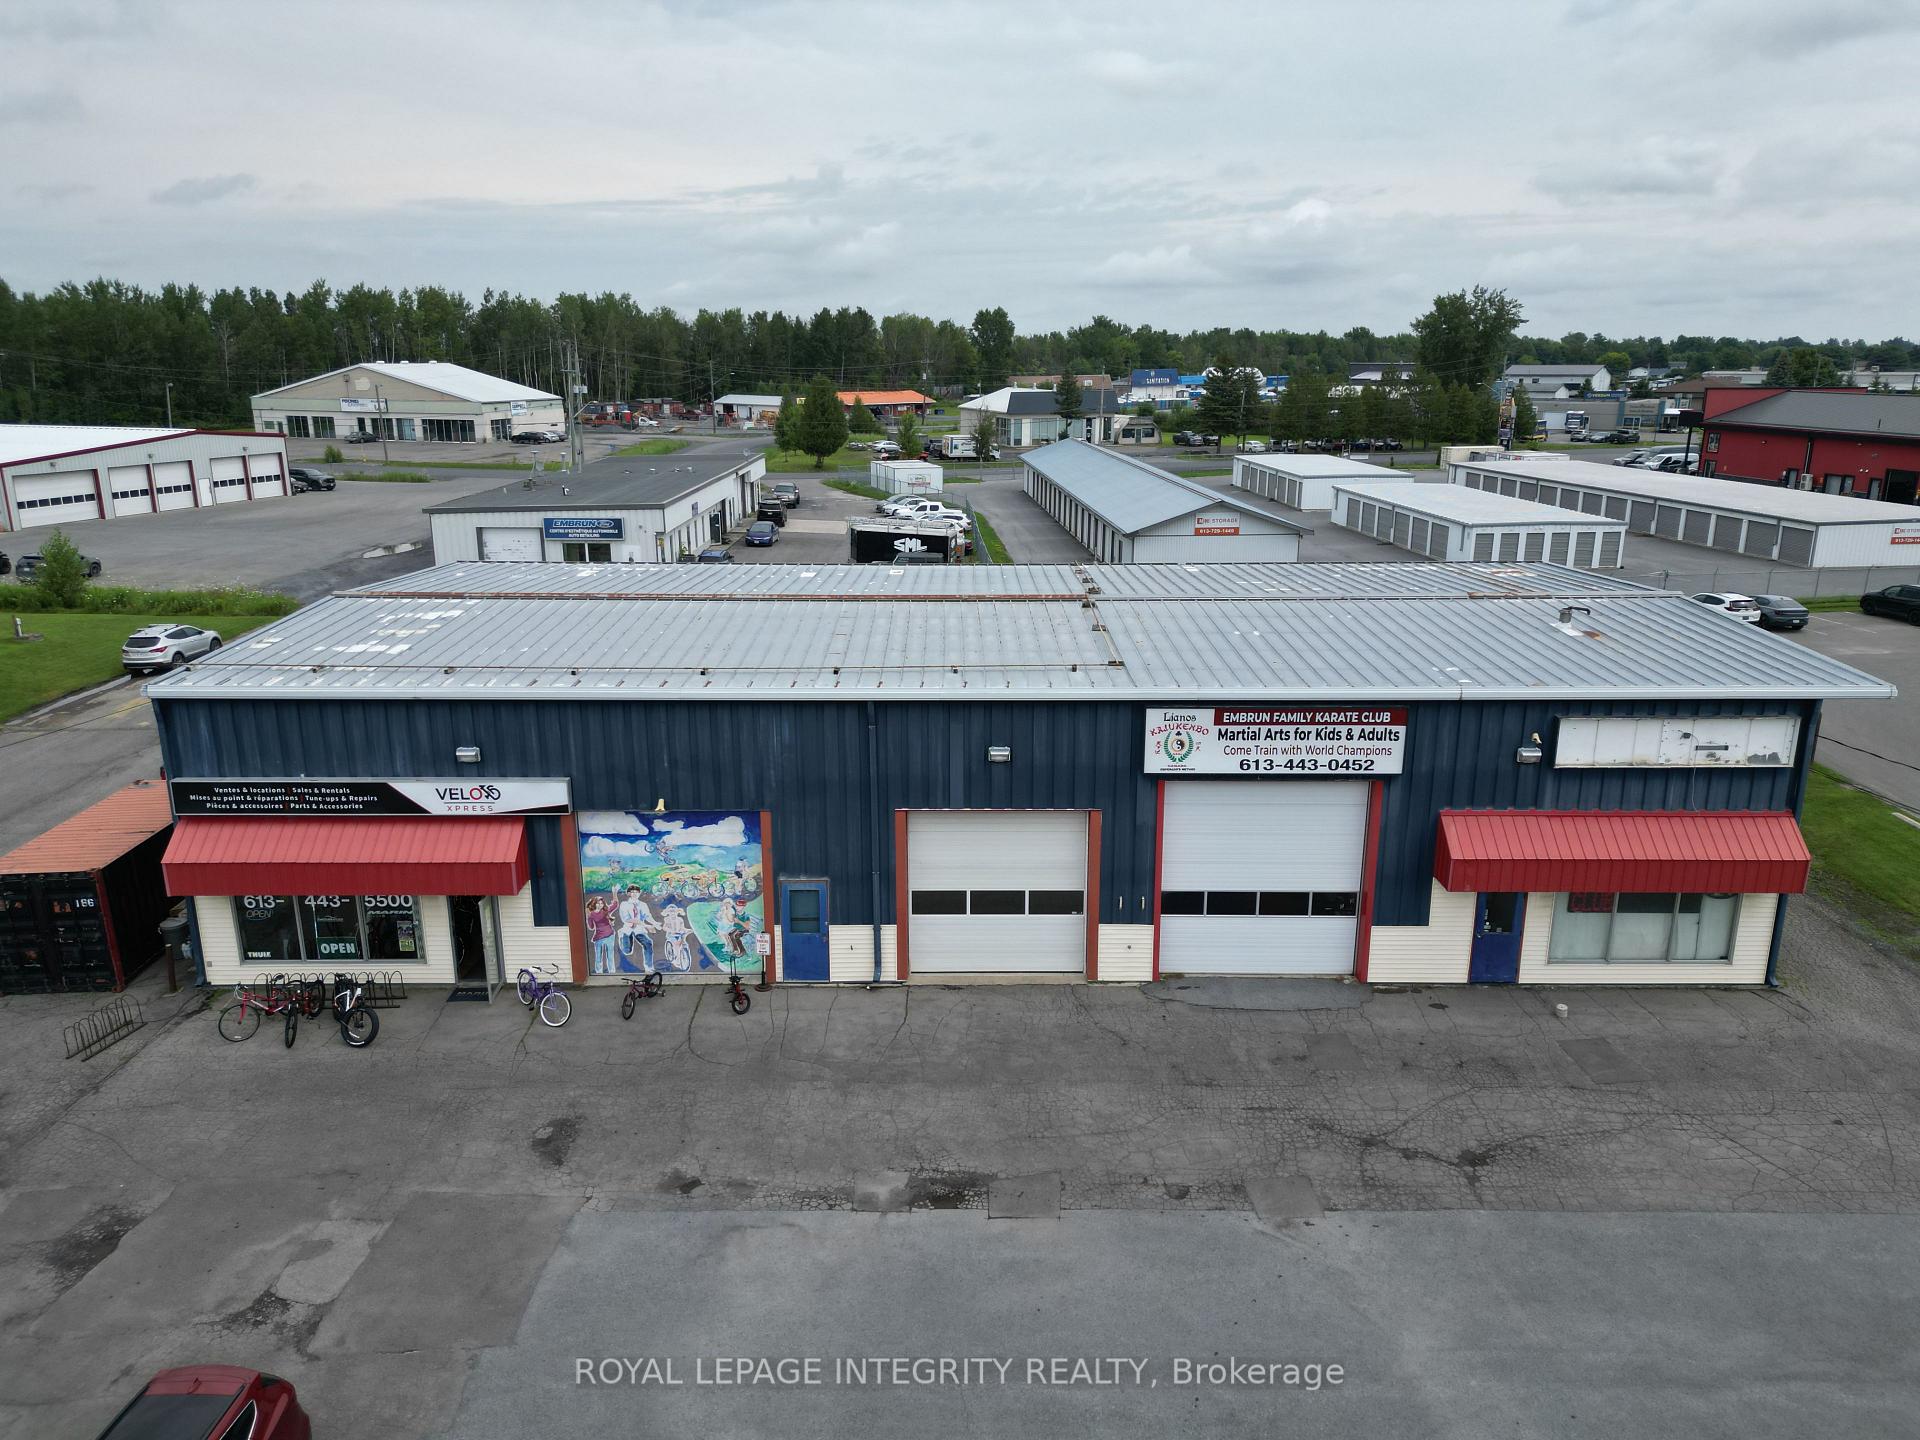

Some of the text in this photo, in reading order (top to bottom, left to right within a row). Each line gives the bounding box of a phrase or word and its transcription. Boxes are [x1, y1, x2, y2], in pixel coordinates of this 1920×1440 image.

[553, 520, 597, 528] EMBRUN
[893, 537, 928, 553] SML
[1223, 712, 1391, 723] EMBRUN FAMILY KARATE CLUB
[1217, 727, 1400, 741] Martial Arts for Kids & Adults
[1223, 745, 1393, 758] Come Train with World Champions
[1239, 759, 1375, 771] 613-443-0452
[223, 795, 246, 803] point
[253, 794, 299, 803] réparations
[305, 795, 340, 803] Tune-ups
[349, 795, 378, 803] Repairs
[244, 895, 413, 909] 613- 443- 5500
[246, 909, 272, 918] OPEN
[320, 943, 356, 954] OPEN
